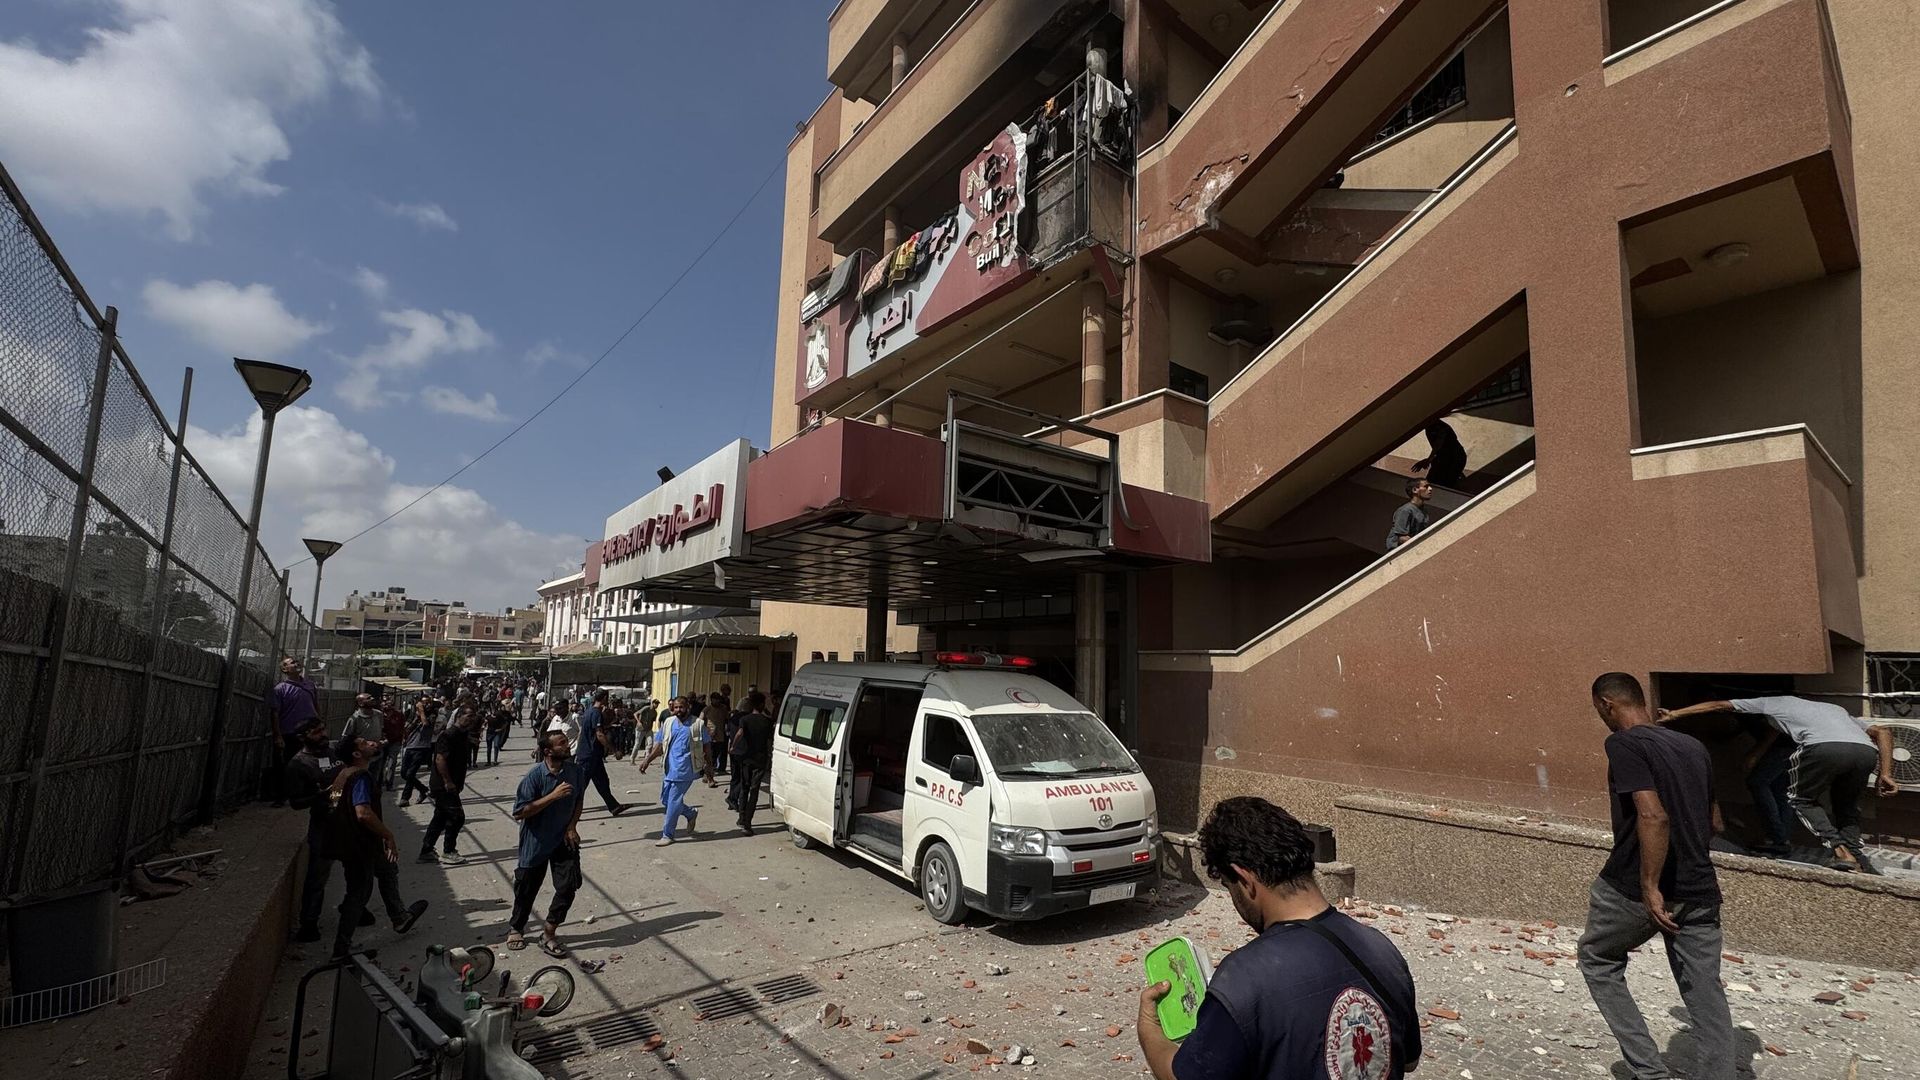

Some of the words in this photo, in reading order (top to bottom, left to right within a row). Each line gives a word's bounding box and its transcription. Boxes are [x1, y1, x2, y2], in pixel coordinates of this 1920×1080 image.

[602, 518, 656, 565] EMERGENCY
[1044, 780, 1138, 800] AMBULANCE
[1089, 797, 1114, 812] 101
